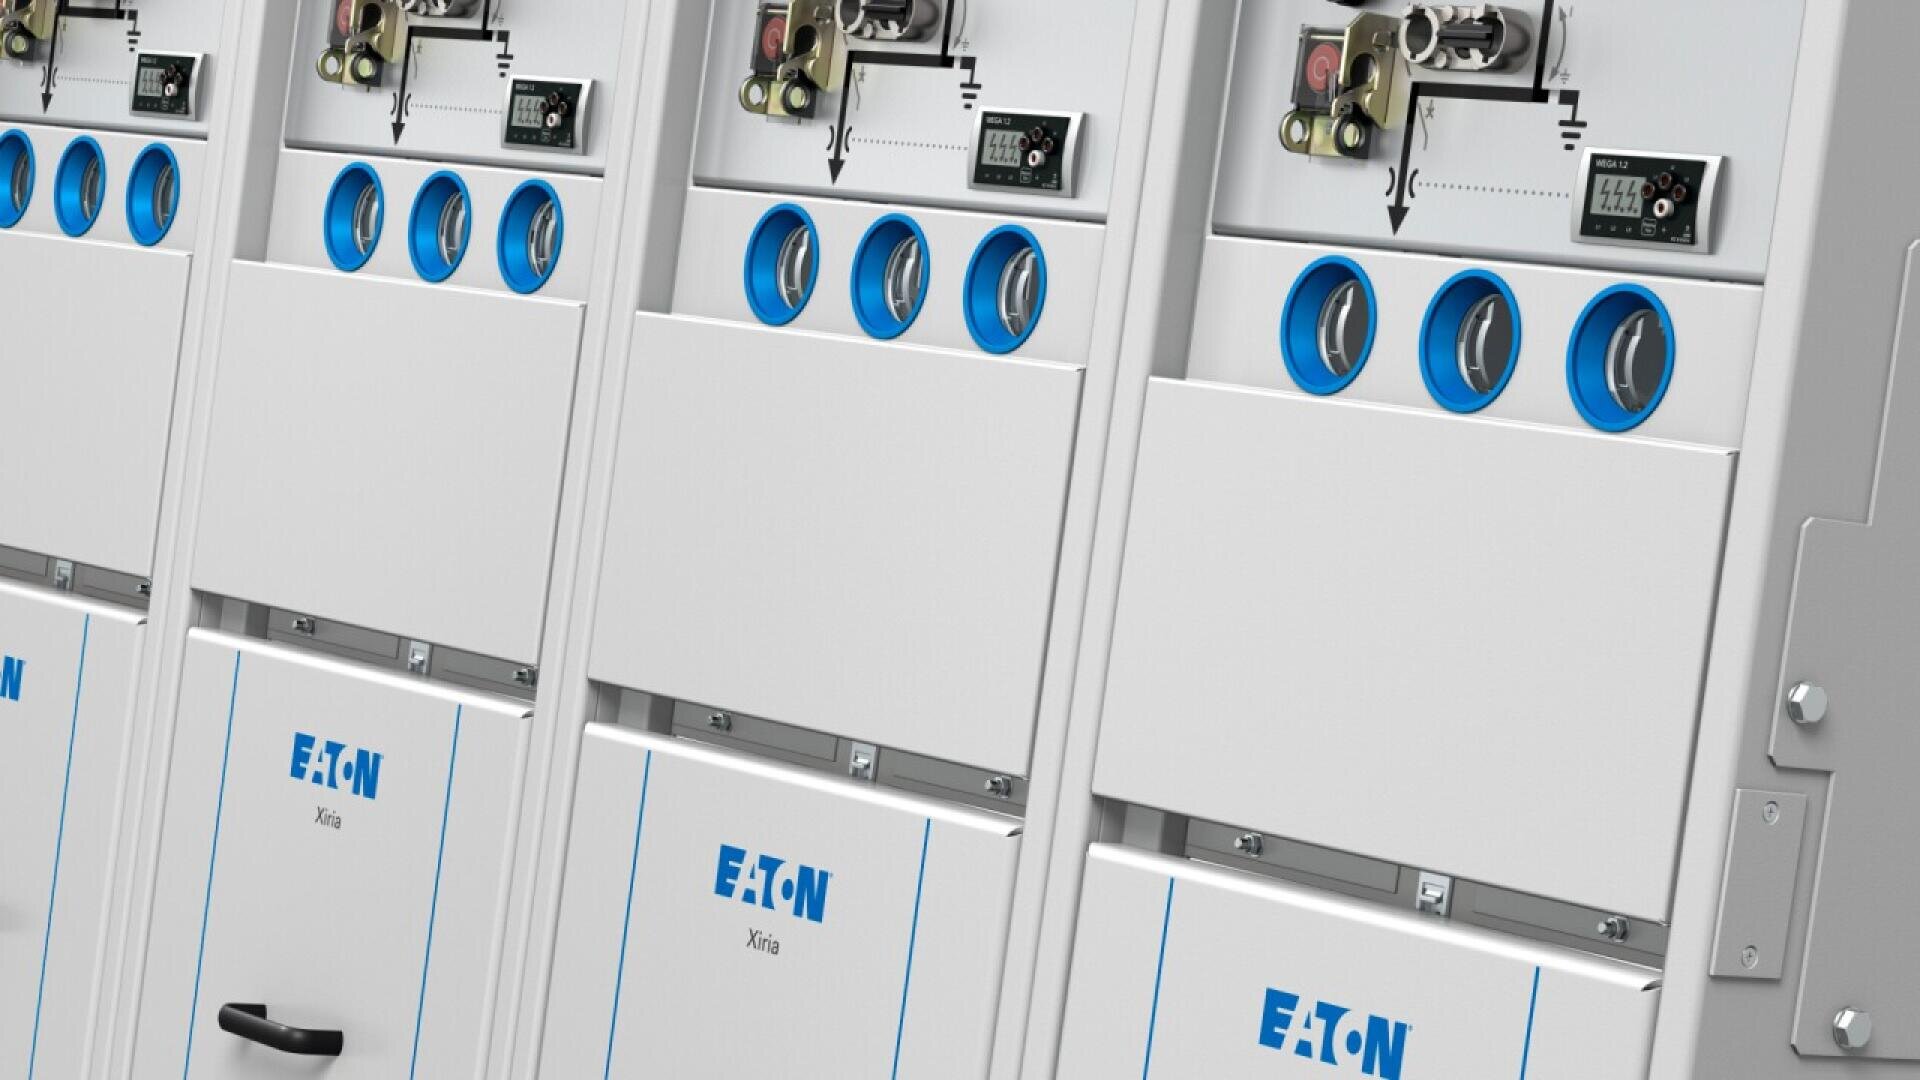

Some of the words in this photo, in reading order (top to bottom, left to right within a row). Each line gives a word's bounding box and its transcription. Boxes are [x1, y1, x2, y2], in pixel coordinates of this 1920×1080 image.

[1595, 158, 1617, 169] WEGA
[0, 655, 24, 701] N
[290, 732, 381, 800] EATON
[315, 806, 342, 829] Xiria
[714, 844, 830, 923] EATON
[746, 928, 780, 955] Xiria
[1258, 987, 1408, 1080] EATON
